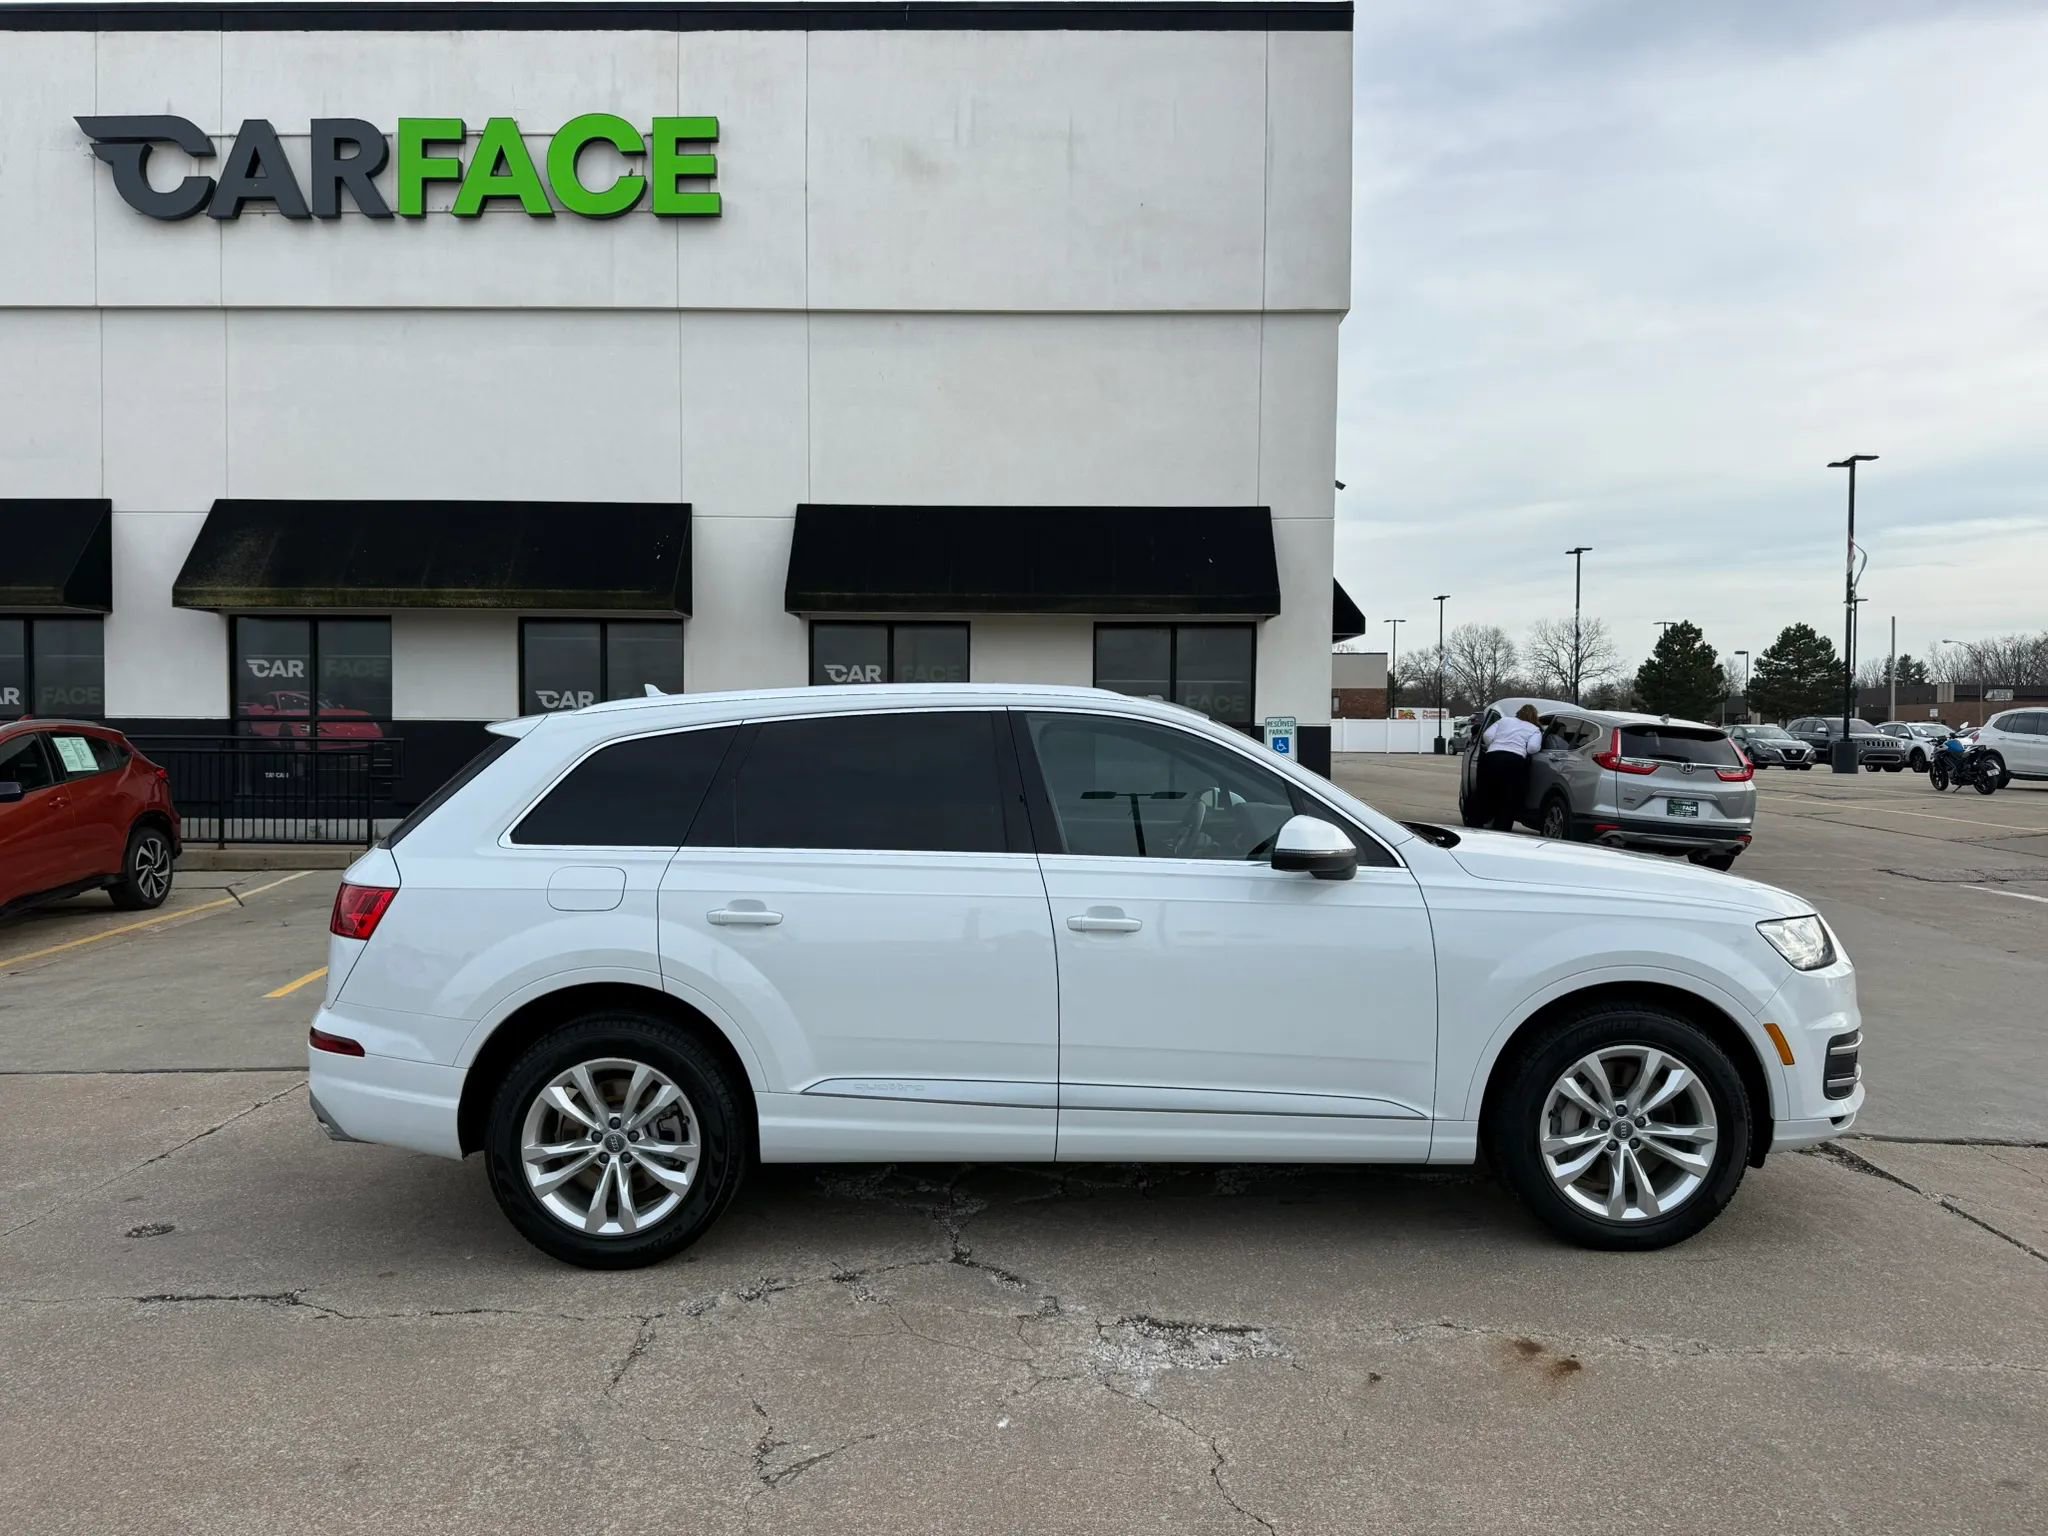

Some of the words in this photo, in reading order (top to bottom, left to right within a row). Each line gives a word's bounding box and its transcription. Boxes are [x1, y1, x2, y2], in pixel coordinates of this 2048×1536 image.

[73, 112, 722, 221] CARFACE
[246, 659, 304, 678] CAR
[325, 660, 386, 678] FACE
[823, 664, 882, 683] CAR
[902, 665, 961, 682] FACE
[41, 687, 102, 705] FACE
[535, 690, 595, 709] CAR
